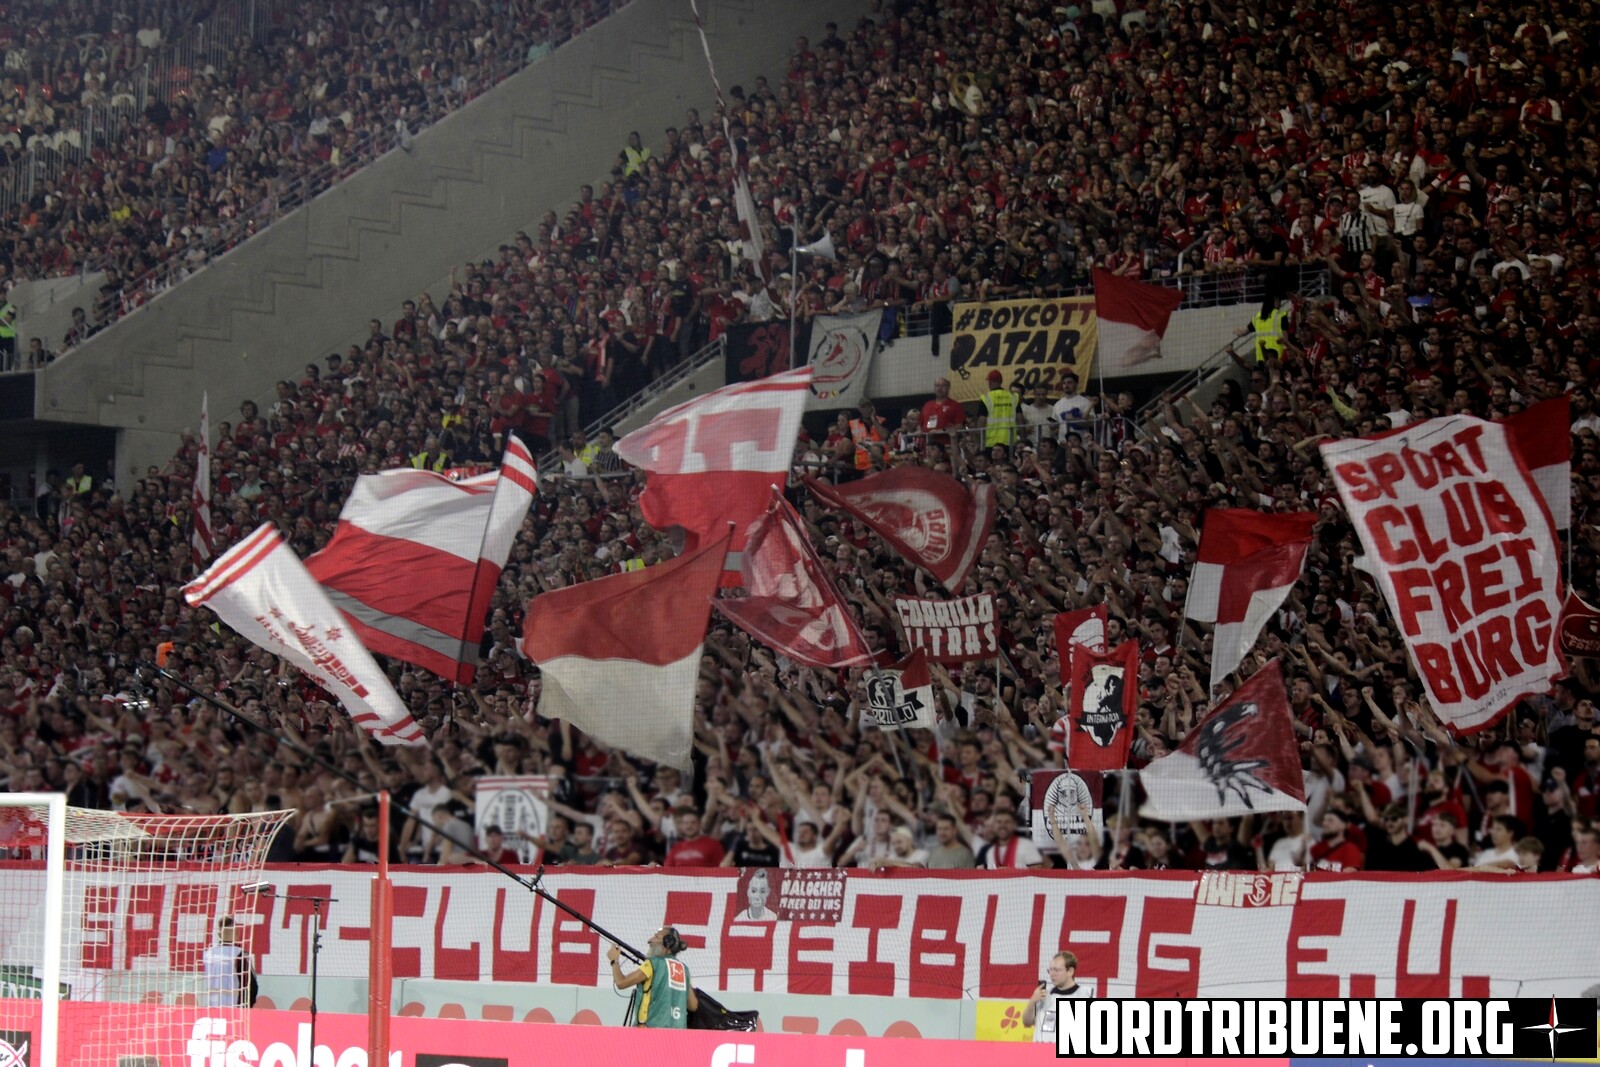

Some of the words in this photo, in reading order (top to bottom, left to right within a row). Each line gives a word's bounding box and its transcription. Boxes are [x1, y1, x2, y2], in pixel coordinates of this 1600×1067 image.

[955, 303, 1097, 331] #BOYCOTT
[1335, 425, 1488, 502] SPORT
[1364, 480, 1527, 565] CLUB
[1388, 537, 1543, 637] FREI
[1412, 599, 1552, 704] BURG
[655, 890, 1201, 998] FREIBURG
[807, 898, 821, 910] BEI
